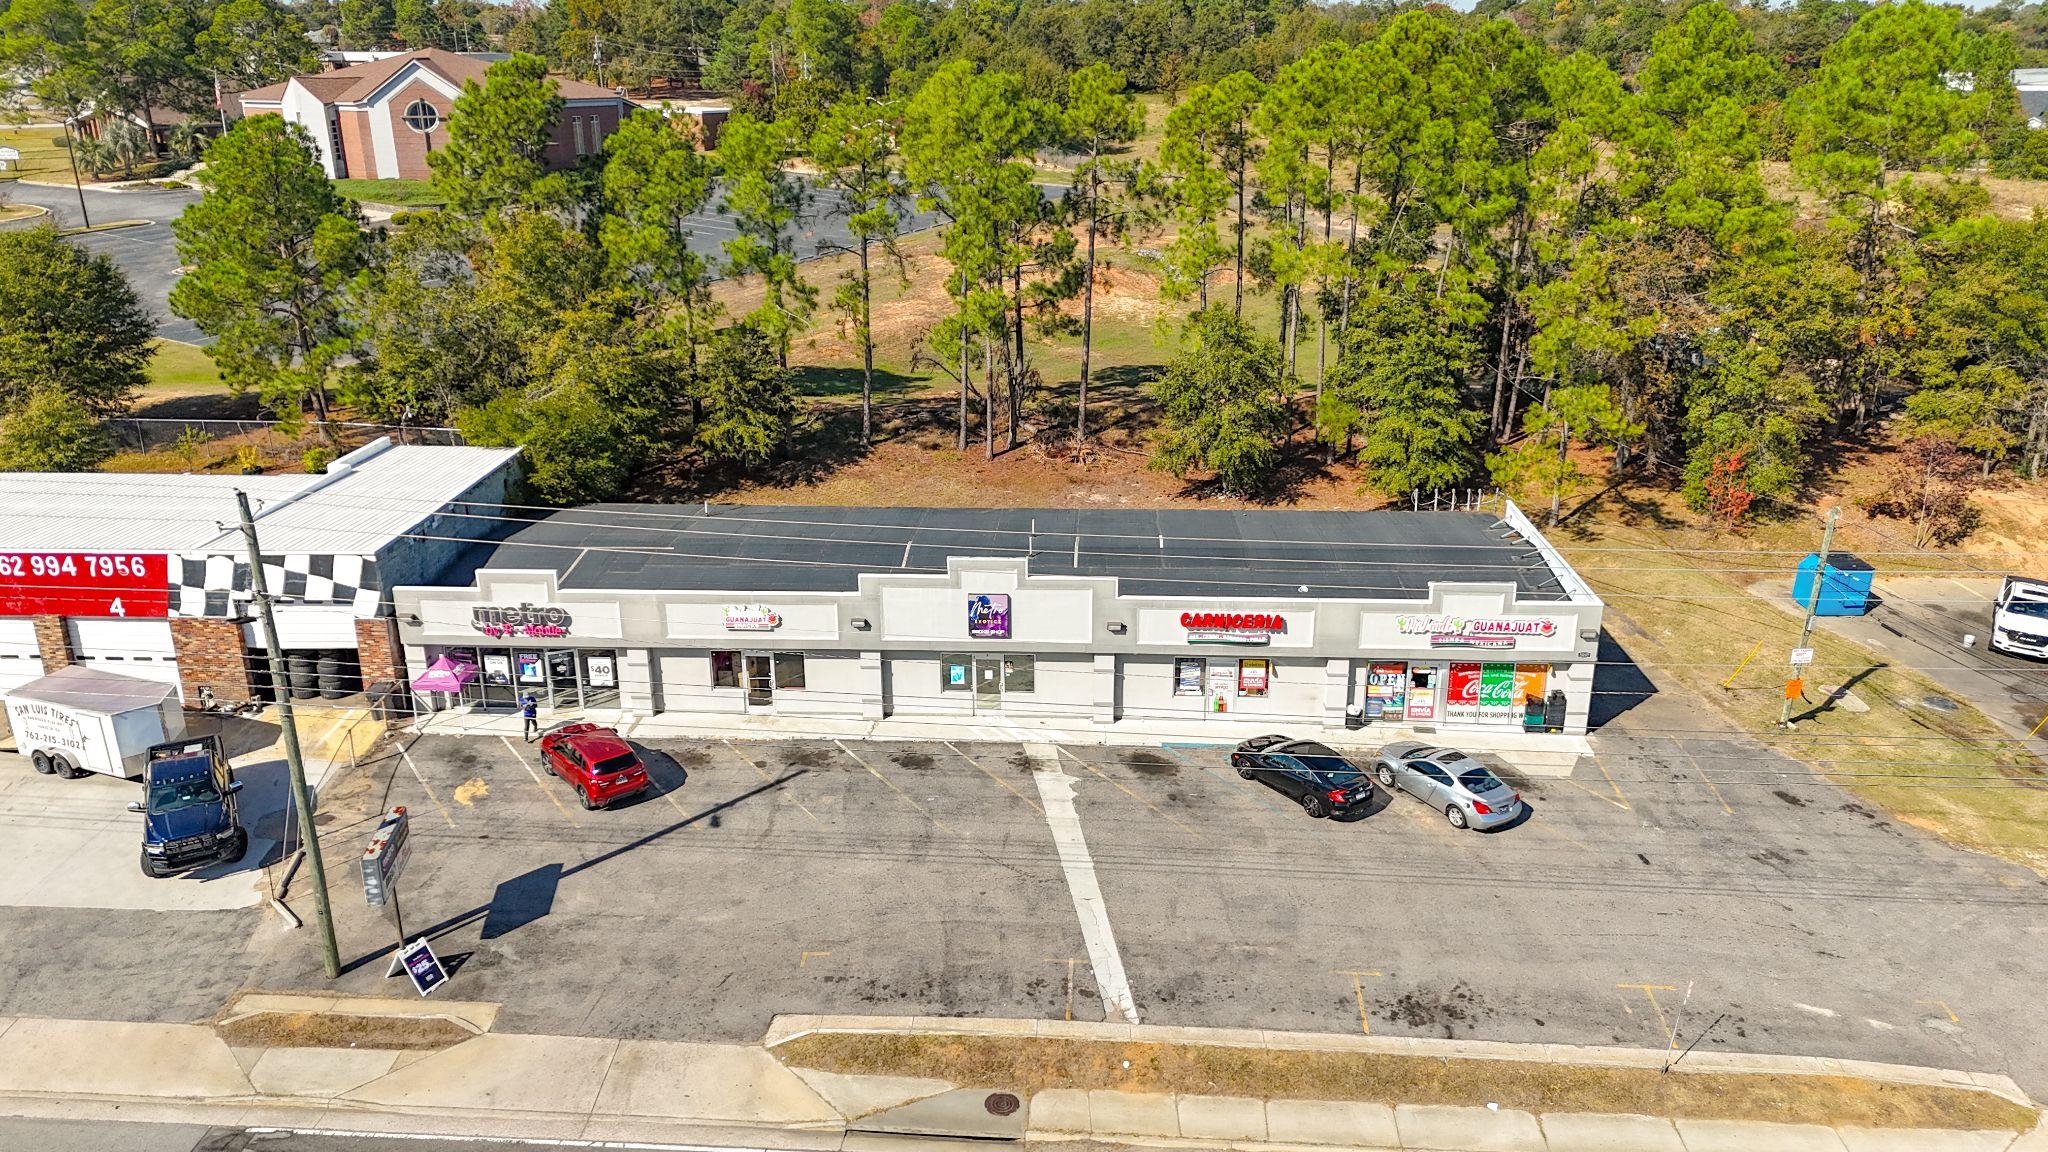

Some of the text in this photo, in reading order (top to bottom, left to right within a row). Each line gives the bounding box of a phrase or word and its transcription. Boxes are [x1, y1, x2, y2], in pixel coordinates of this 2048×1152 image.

[0, 555, 146, 577] 62 994 7956
[109, 597, 126, 617] 4
[472, 602, 567, 626] metro
[1181, 612, 1284, 630] CARNICERIA
[590, 665, 610, 675] $40
[1369, 673, 1406, 686] OPEN
[15, 704, 30, 717] SAN
[31, 704, 48, 715] LUIS
[51, 708, 77, 727] TIRES
[24, 730, 81, 749] 762-215-3102
